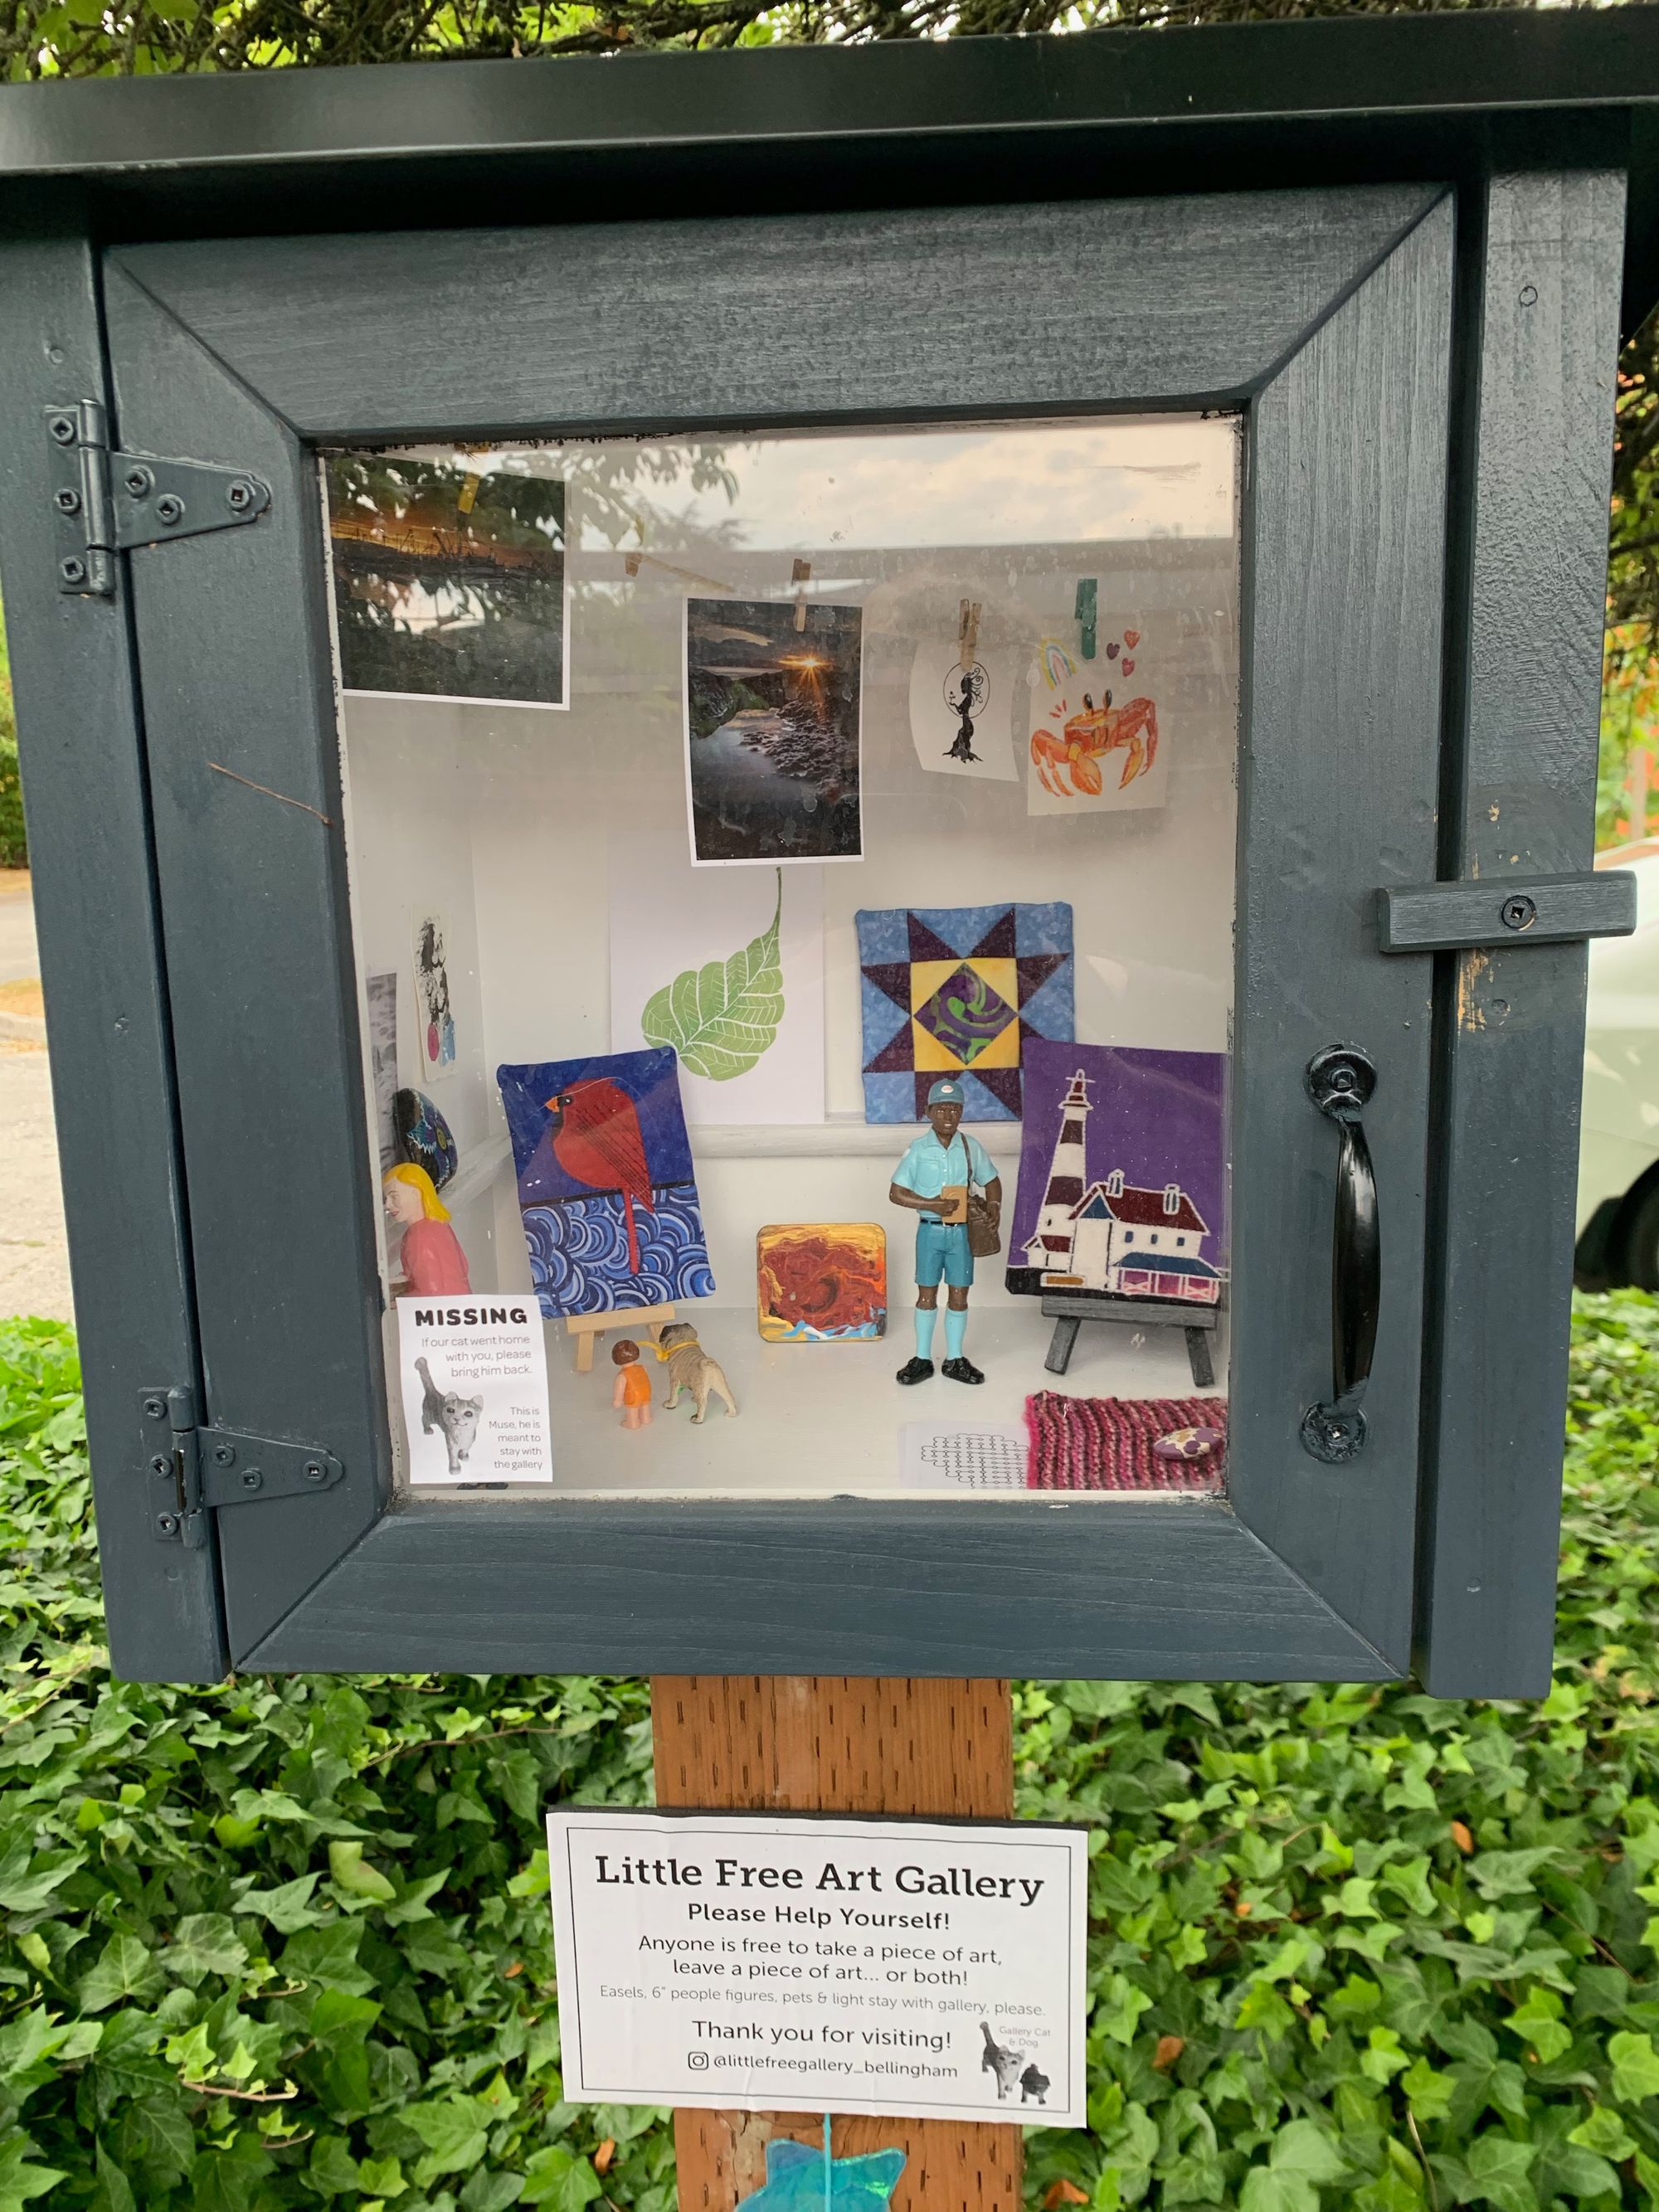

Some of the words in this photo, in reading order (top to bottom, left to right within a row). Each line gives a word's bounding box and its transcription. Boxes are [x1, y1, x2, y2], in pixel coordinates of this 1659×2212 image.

[415, 1308, 528, 1326] MISSING
[421, 1337, 430, 1348] If
[431, 1339, 449, 1347] our
[451, 1338, 468, 1346] cat
[469, 1336, 497, 1345] went
[498, 1335, 530, 1344] home
[445, 1351, 469, 1362] with
[470, 1353, 494, 1363] you,
[496, 1350, 532, 1362] please
[451, 1367, 479, 1378] bring
[481, 1366, 502, 1376] him
[504, 1364, 533, 1374] back.
[510, 1407, 531, 1415] This
[532, 1407, 540, 1415] is
[489, 1421, 517, 1429] Muse,
[533, 1420, 541, 1428] is
[498, 1434, 529, 1442] meant
[531, 1434, 541, 1442] to
[500, 1448, 520, 1457] stay
[522, 1446, 542, 1456] with
[494, 1461, 510, 1469] the
[511, 1461, 542, 1471] gallery
[596, 1855, 702, 1885] Little
[715, 1859, 803, 1889] Free
[816, 1863, 882, 1892] Art
[896, 1866, 1044, 1907] Gallery
[688, 1903, 766, 1922] Please
[776, 1906, 831, 1928] Help
[839, 1908, 950, 1929] Yourself!
[639, 1935, 715, 1953] Anyone
[722, 1937, 736, 1952] is
[742, 1938, 781, 1952] free
[788, 1940, 808, 1954] to
[815, 1942, 857, 1957] take
[864, 1946, 874, 1957] a
[882, 1944, 936, 1962] piece
[943, 1947, 964, 1962] of
[969, 1949, 1002, 1966] art,
[674, 1959, 725, 1975] leave
[732, 1964, 742, 1976] a
[749, 1962, 802, 1979] piece
[809, 1964, 830, 1979] of
[835, 1966, 879, 1981] art...
[886, 1970, 907, 1982] or
[914, 1969, 967, 1986] both!
[600, 1985, 647, 1999] Easels,
[652, 1986, 666, 1998] 6"
[671, 1988, 721, 2002] people
[726, 1989, 778, 2003] figures,
[783, 1992, 813, 2004] pets
[817, 1994, 827, 2005] &
[833, 1993, 864, 2007] light
[868, 1996, 898, 2010] stay
[902, 1997, 933, 2010] with
[938, 1998, 990, 2015] gallery,
[995, 2001, 1046, 2016] please.
[692, 2020, 763, 2039] Thank
[770, 2026, 813, 2044] you
[821, 2025, 854, 2043] for
[861, 2029, 951, 2053] visiting!
[999, 2025, 1032, 2036] Gallery
[1034, 2028, 1051, 2037] Cat
[1019, 2039, 1039, 2048] Dog
[713, 2054, 958, 2078] @littlefreegallery_bellingham
